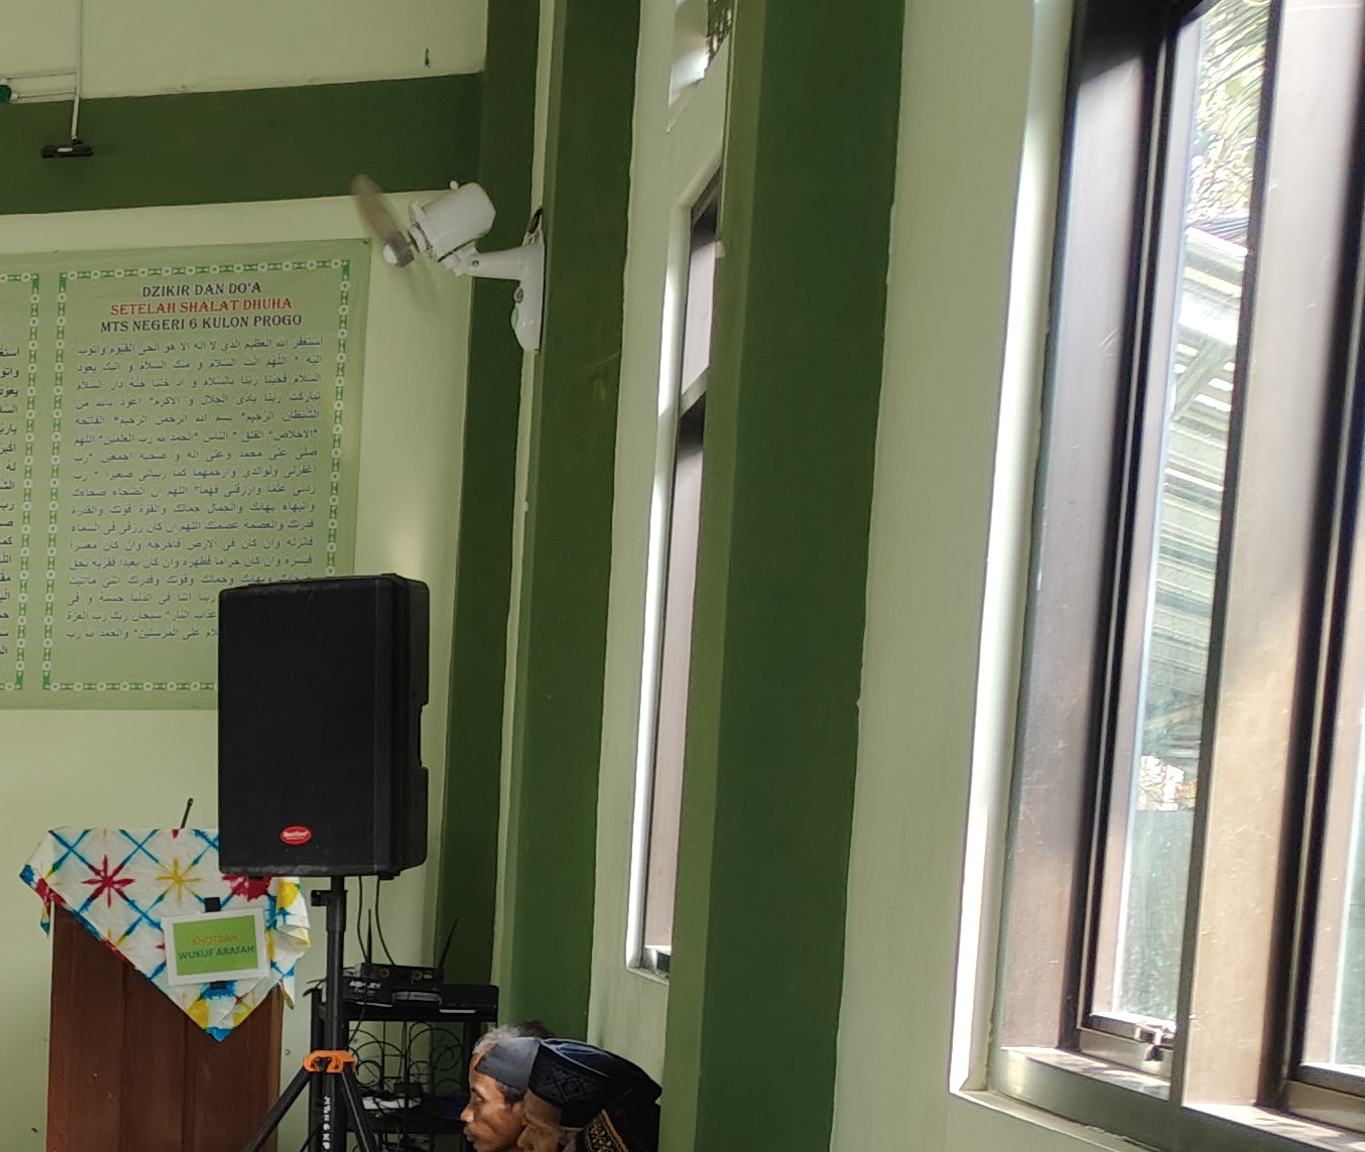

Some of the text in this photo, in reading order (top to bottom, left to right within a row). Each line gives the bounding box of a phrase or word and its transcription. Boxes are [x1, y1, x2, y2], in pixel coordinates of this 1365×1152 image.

[143, 285, 189, 297] DZIKIR
[195, 284, 224, 295] DAN
[111, 298, 292, 315] SETELAH SHALAT DHUHA
[101, 314, 302, 333] MTS NEGERI 6 KULON PROGO
